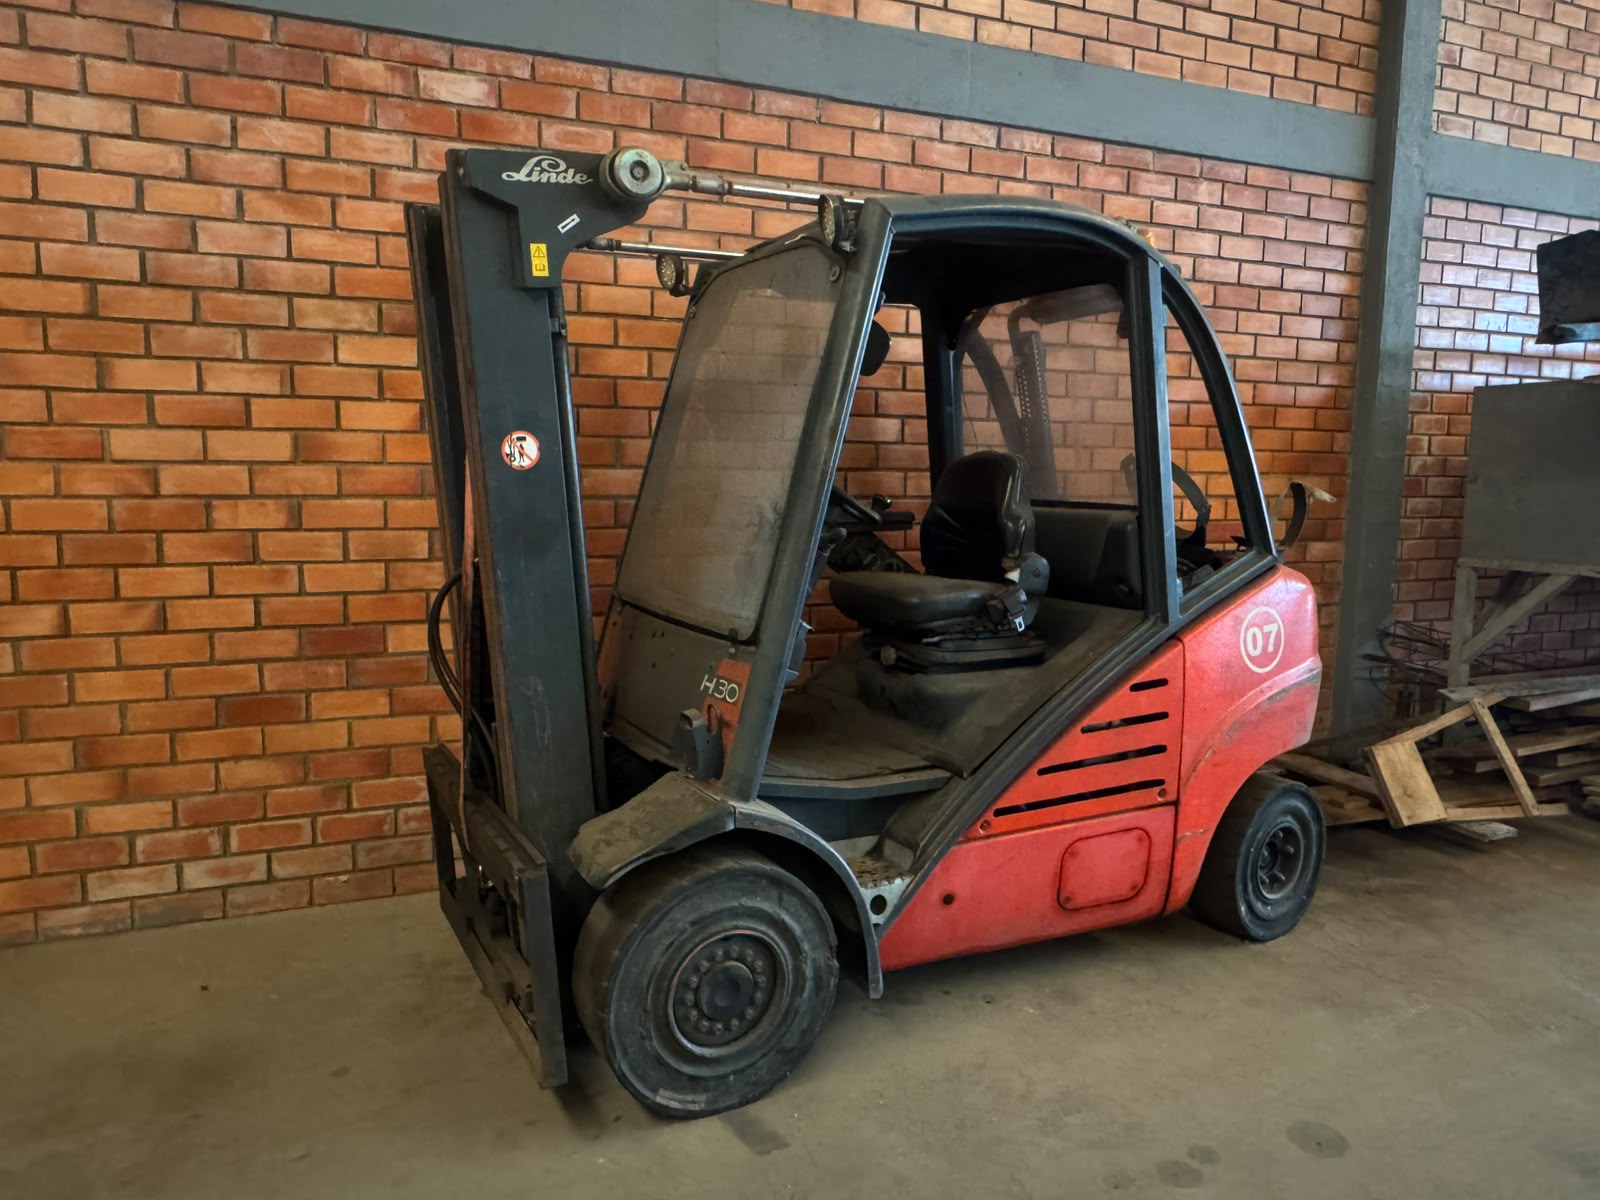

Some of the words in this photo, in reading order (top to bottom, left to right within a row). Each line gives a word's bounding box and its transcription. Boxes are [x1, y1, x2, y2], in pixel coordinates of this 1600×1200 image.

[501, 155, 593, 184] Linde
[1246, 622, 1279, 657] 07
[700, 674, 739, 703] H30
